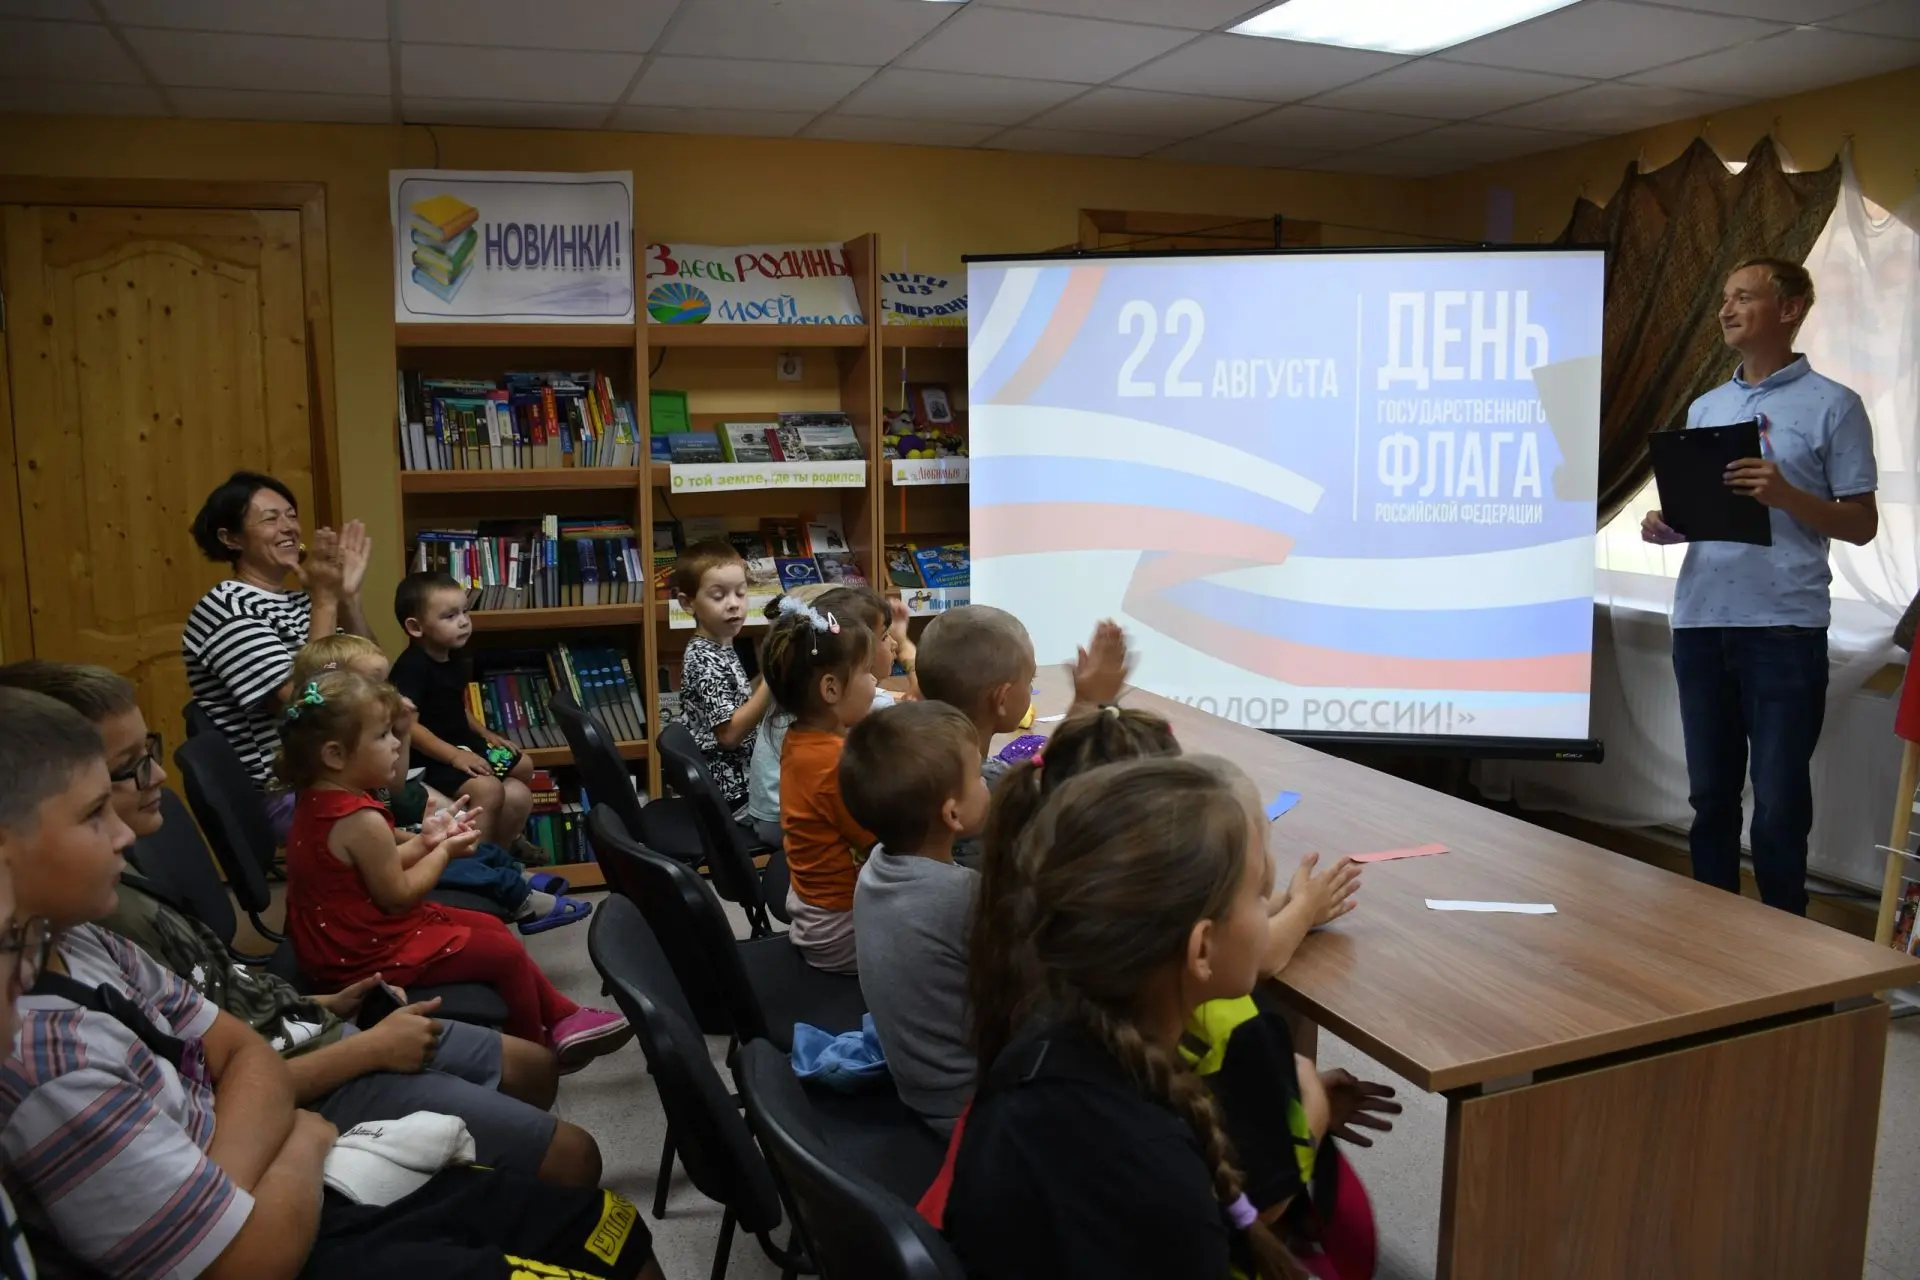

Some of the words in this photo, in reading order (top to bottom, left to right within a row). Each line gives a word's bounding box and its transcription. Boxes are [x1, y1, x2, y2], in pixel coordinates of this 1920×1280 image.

[485, 219, 622, 268] НОВИНКИ!
[896, 284, 933, 296] из
[1117, 297, 1205, 397] 22
[1212, 358, 1339, 399] АВГУСТА
[1377, 290, 1549, 391] ДЕНЬ
[1377, 399, 1546, 425] ГОСУДАРСТВЕННОГО
[1378, 430, 1543, 498] ФЛАГА
[673, 475, 684, 488] О
[688, 473, 713, 487] той
[793, 473, 809, 484] ты
[1375, 501, 1458, 523] РОССИЙСКОЙ
[1460, 503, 1543, 526] ФЕДЕРАЦИИ
[929, 598, 952, 610] Мои
[1303, 698, 1476, 729] РОССИИ!»
